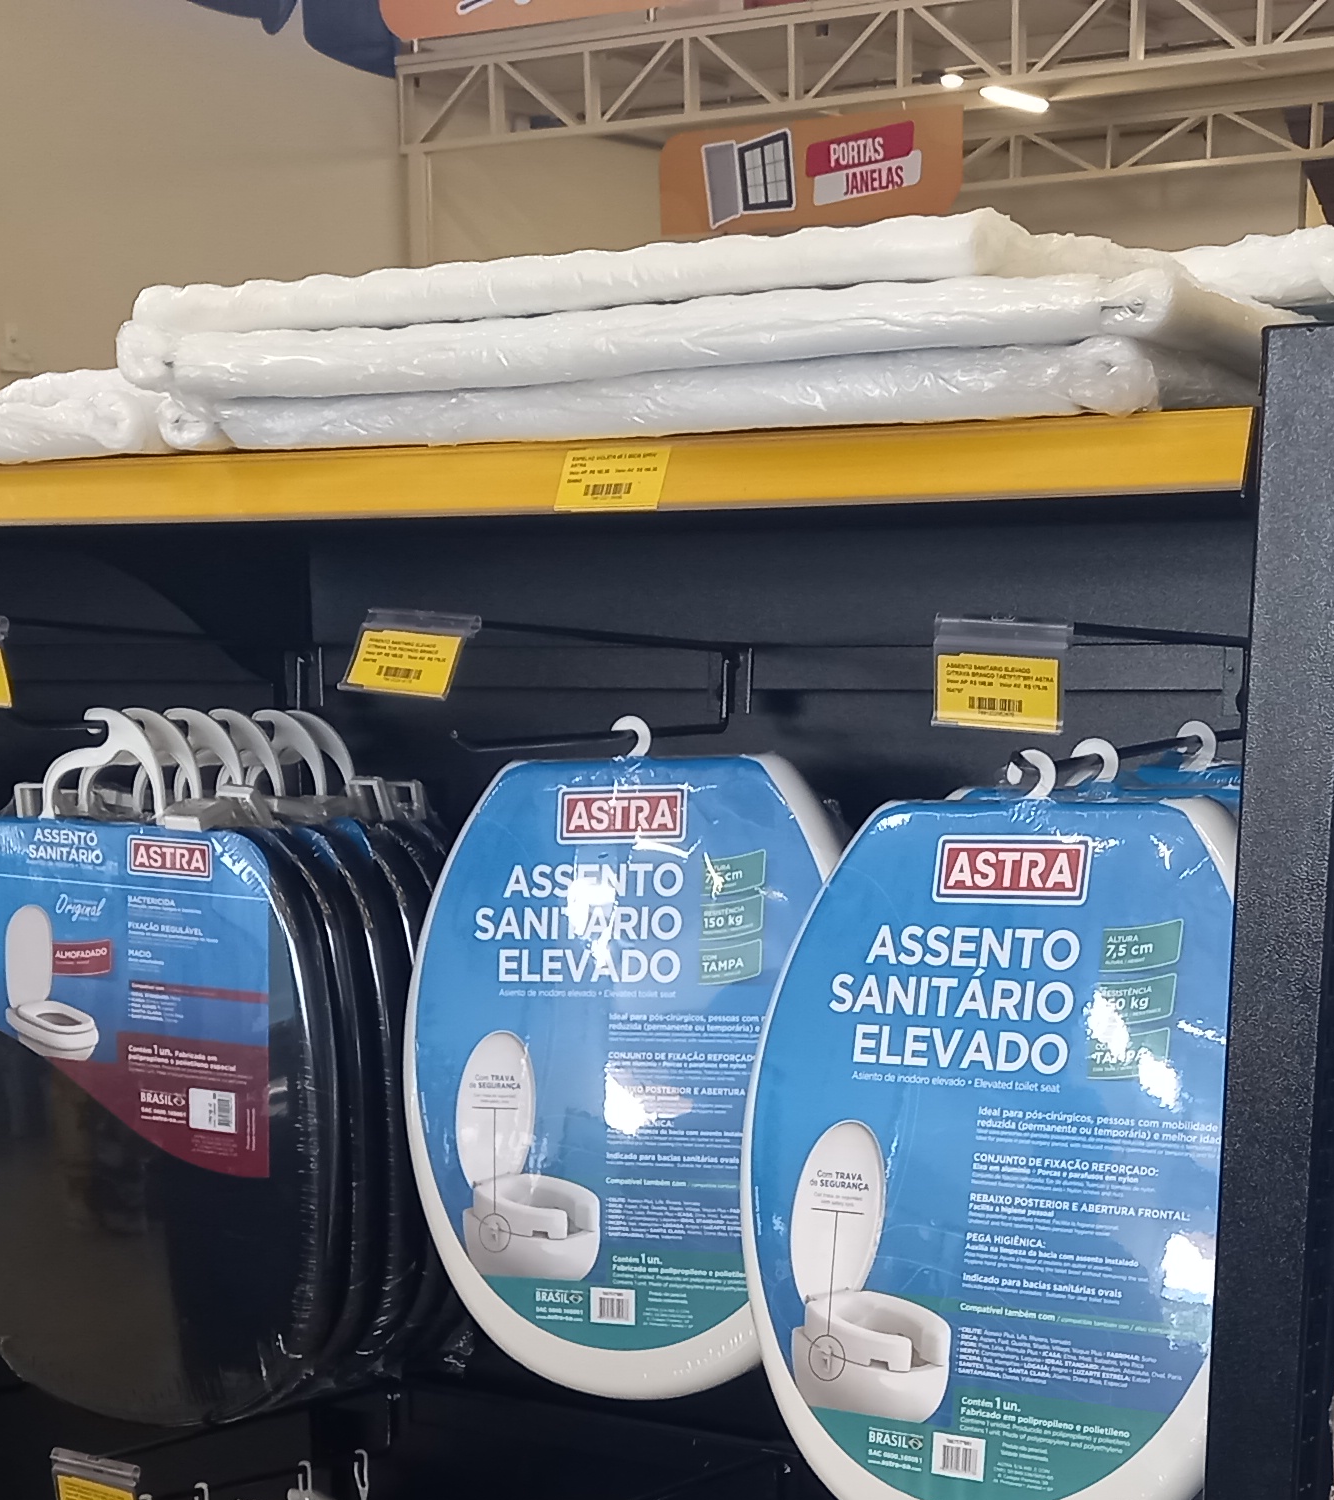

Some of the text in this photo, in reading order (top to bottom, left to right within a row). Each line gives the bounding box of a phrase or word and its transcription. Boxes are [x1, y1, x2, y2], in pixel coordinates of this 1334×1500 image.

[830, 137, 884, 168] PORTAS
[844, 165, 904, 196] JANELAS
[569, 799, 674, 831] ASTRA
[34, 828, 97, 847] ASSENTO
[28, 844, 103, 864] SANITÁRIO
[135, 845, 205, 871] ASTRA
[946, 851, 1073, 889] ASTRA
[56, 894, 106, 922] Original
[161, 924, 203, 936] REGULÁVEL
[704, 915, 743, 928] 150 kg
[865, 924, 1081, 971] ASSENTO
[1107, 934, 1139, 944] ALTURA
[55, 948, 107, 959] ALMOFADADO
[1105, 942, 1153, 959] 7,5 cm
[499, 948, 681, 983] ELEVADO
[702, 958, 744, 972] TAMPA
[828, 968, 1074, 1023] SANITÁRIO
[1131, 996, 1149, 1011] kg
[852, 1024, 1069, 1075] ELEVADO
[852, 1070, 1060, 1093] Asiento de inodoro elevado Elevated toilet seat
[141, 1092, 173, 1106] BRASIL
[978, 1106, 1218, 1133] Ideal para pós-cirúrgicos, pessoas com mobilidade
[977, 1119, 1222, 1145] reduzida (permanente ou temporária) e melhor idad
[974, 1152, 1159, 1177] CONJUNTO DE FIXAÇÃO REFORÇADO:
[817, 1170, 863, 1181] Com TRAVA
[820, 1179, 869, 1192] SEGURANÇA
[970, 1193, 1191, 1221] REBAIXO POSTERIOR E ABERTURA FRONTAL:
[966, 1233, 1046, 1248] PEGA HIGIÊNICA:
[962, 1273, 1122, 1298] Indicado para bacias sanitárias ovais
[535, 1291, 569, 1303] BRASIL
[960, 1302, 1055, 1322] Compatível também com
[961, 1397, 1021, 1412] Contém 1 un.
[961, 1407, 1130, 1438] Fabricado em polipropileno e polietileno
[868, 1431, 909, 1448] BRASIL
